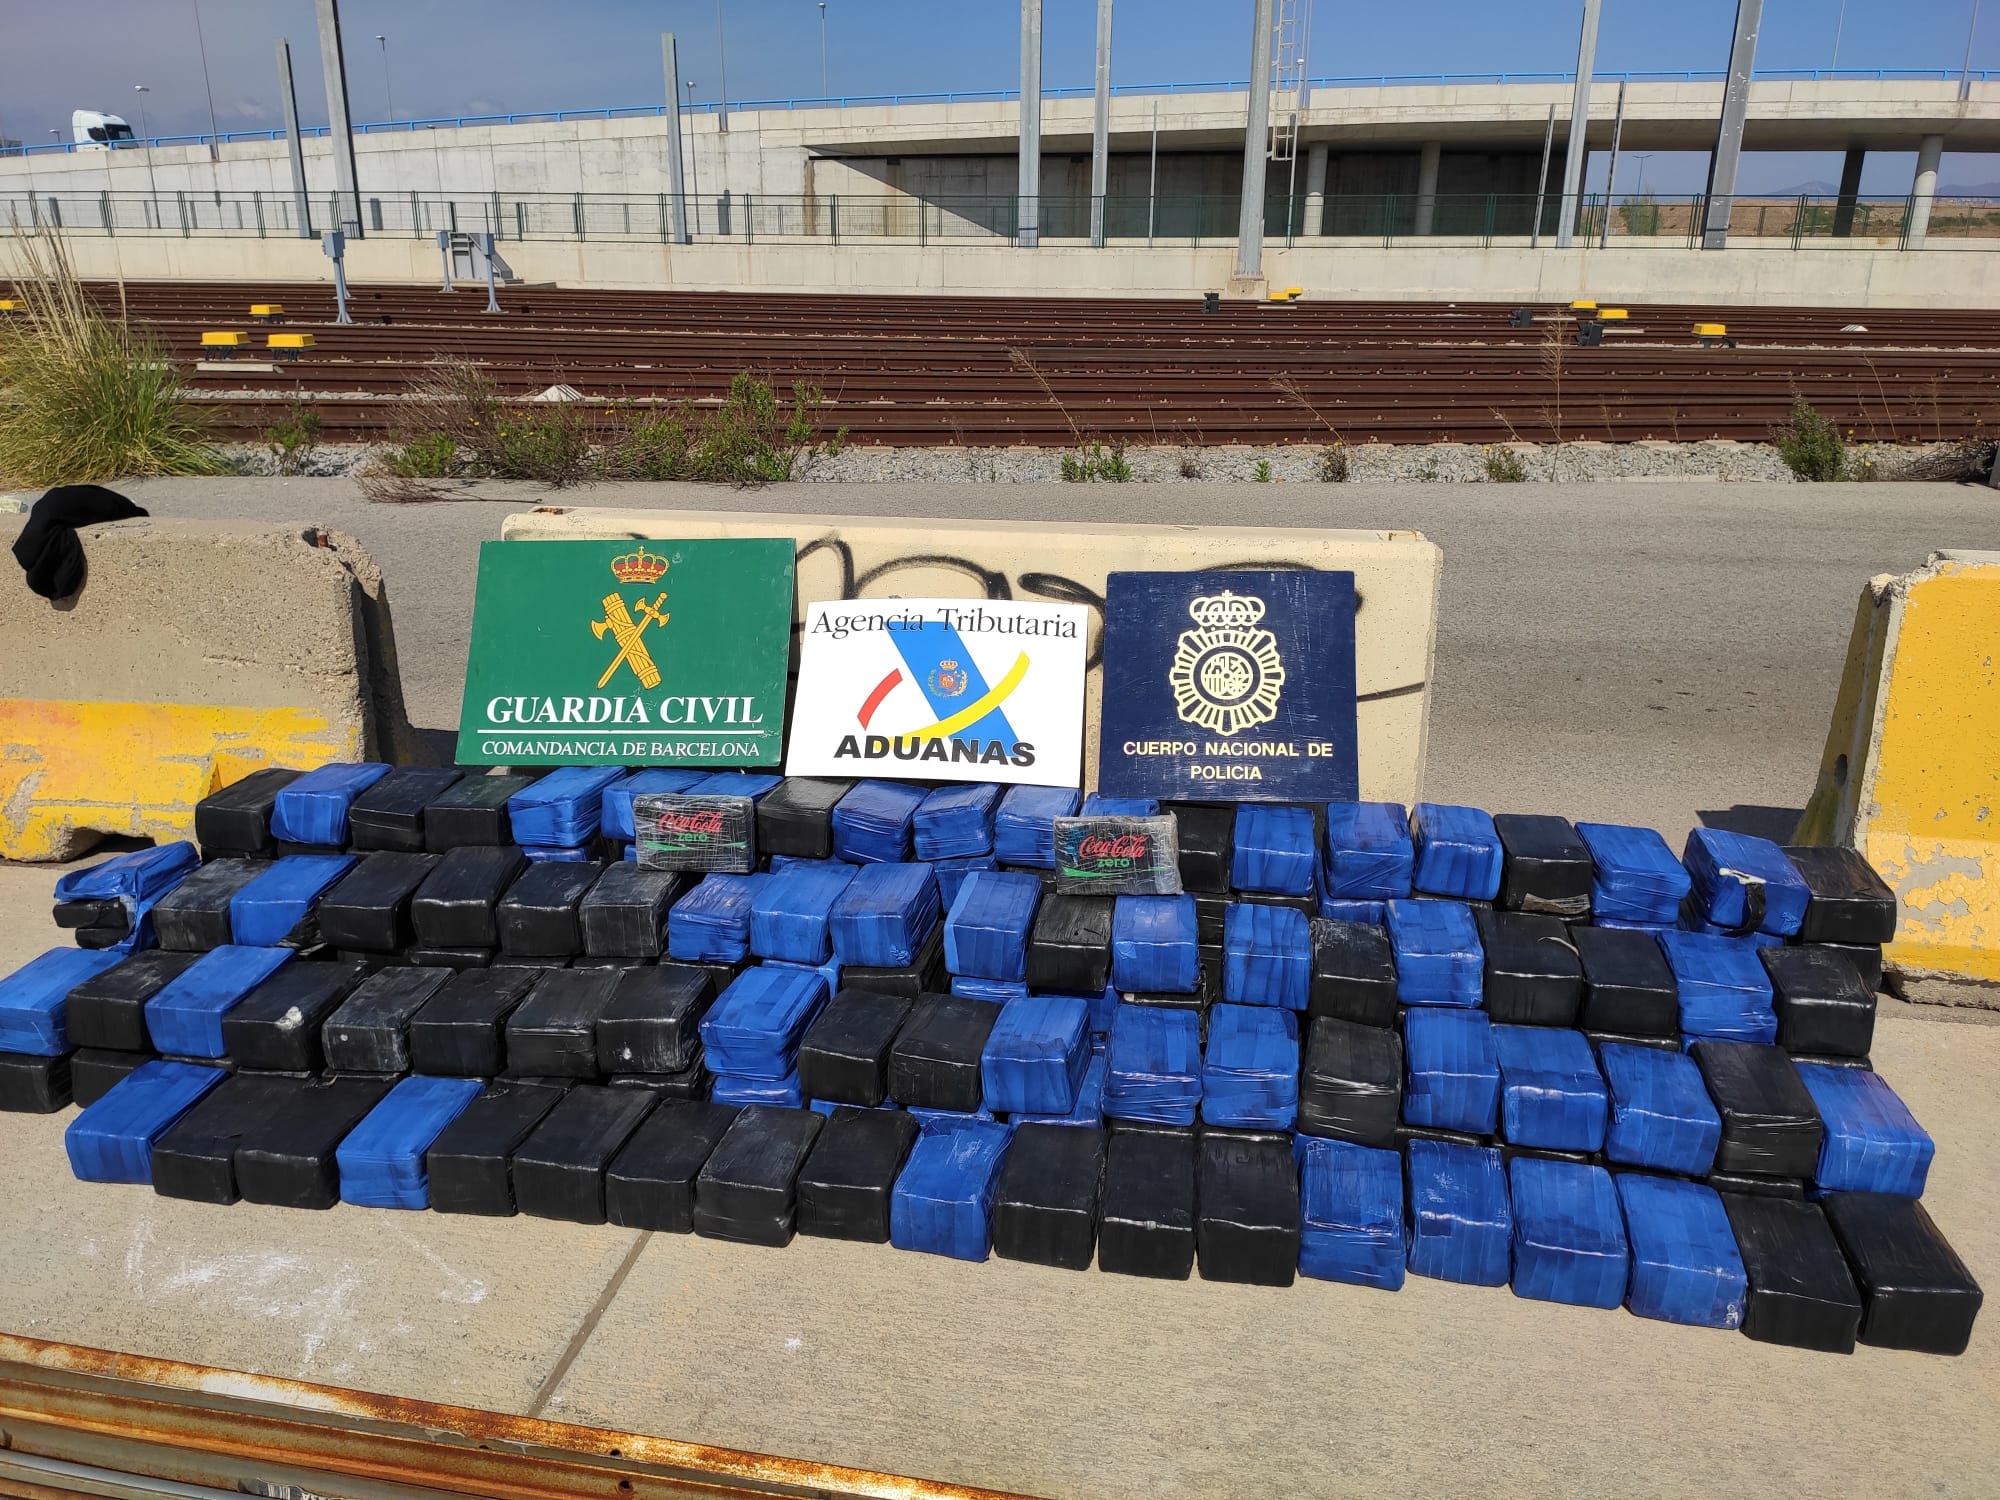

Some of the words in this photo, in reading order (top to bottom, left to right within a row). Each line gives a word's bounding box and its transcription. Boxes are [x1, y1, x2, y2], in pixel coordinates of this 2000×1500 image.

[811, 607, 924, 640] Agencia
[936, 606, 1078, 639] Tributaria
[486, 696, 650, 725] GUARDIA
[660, 696, 764, 725] CIVIL
[481, 740, 618, 757] COMANDANCIA
[622, 741, 646, 757] DE
[650, 741, 760, 758] BARCELONA
[833, 734, 1036, 767] ADUANAS
[1123, 741, 1197, 756] CUERPO
[1205, 741, 1300, 757] NACIONAL
[1307, 742, 1334, 757] DE
[1190, 765, 1263, 780] POLICIA
[676, 832, 708, 842] zero
[1096, 858, 1130, 868] zero
